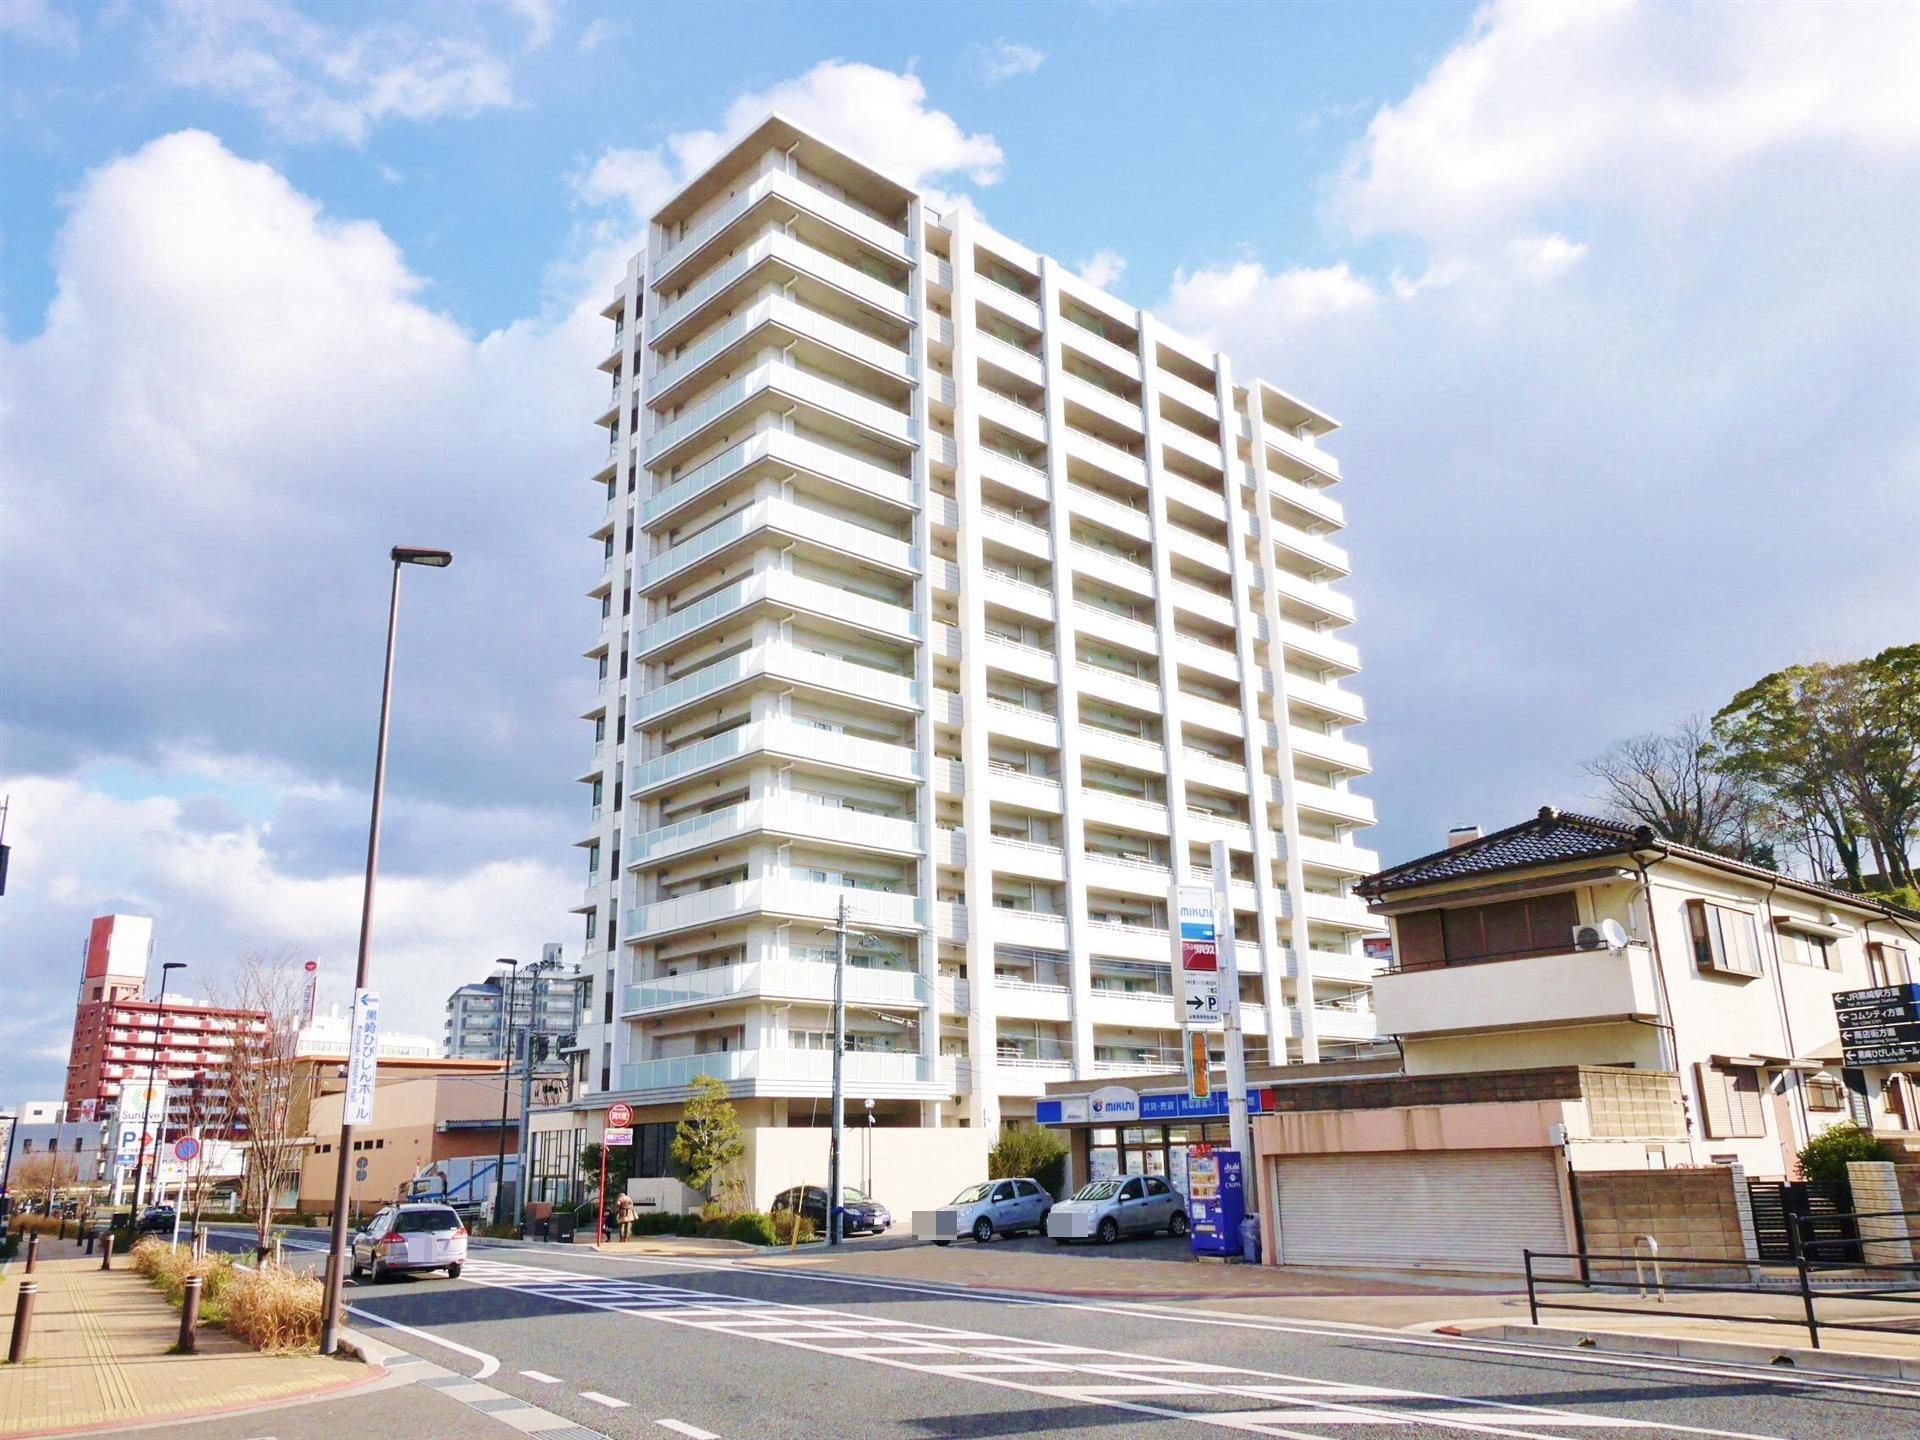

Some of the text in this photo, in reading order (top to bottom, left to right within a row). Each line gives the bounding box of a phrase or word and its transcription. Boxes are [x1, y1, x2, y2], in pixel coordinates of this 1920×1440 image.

[1846, 988, 1900, 1002] JR黒崎駅方面
[1208, 997, 1216, 1010] P
[1850, 1007, 1904, 1020] コムシティ方面
[1854, 1027, 1897, 1039] 商店街方面
[356, 1009, 377, 1120] 黒崎ひびしんホール
[122, 1110, 161, 1120] SunLve
[122, 1131, 136, 1148] P
